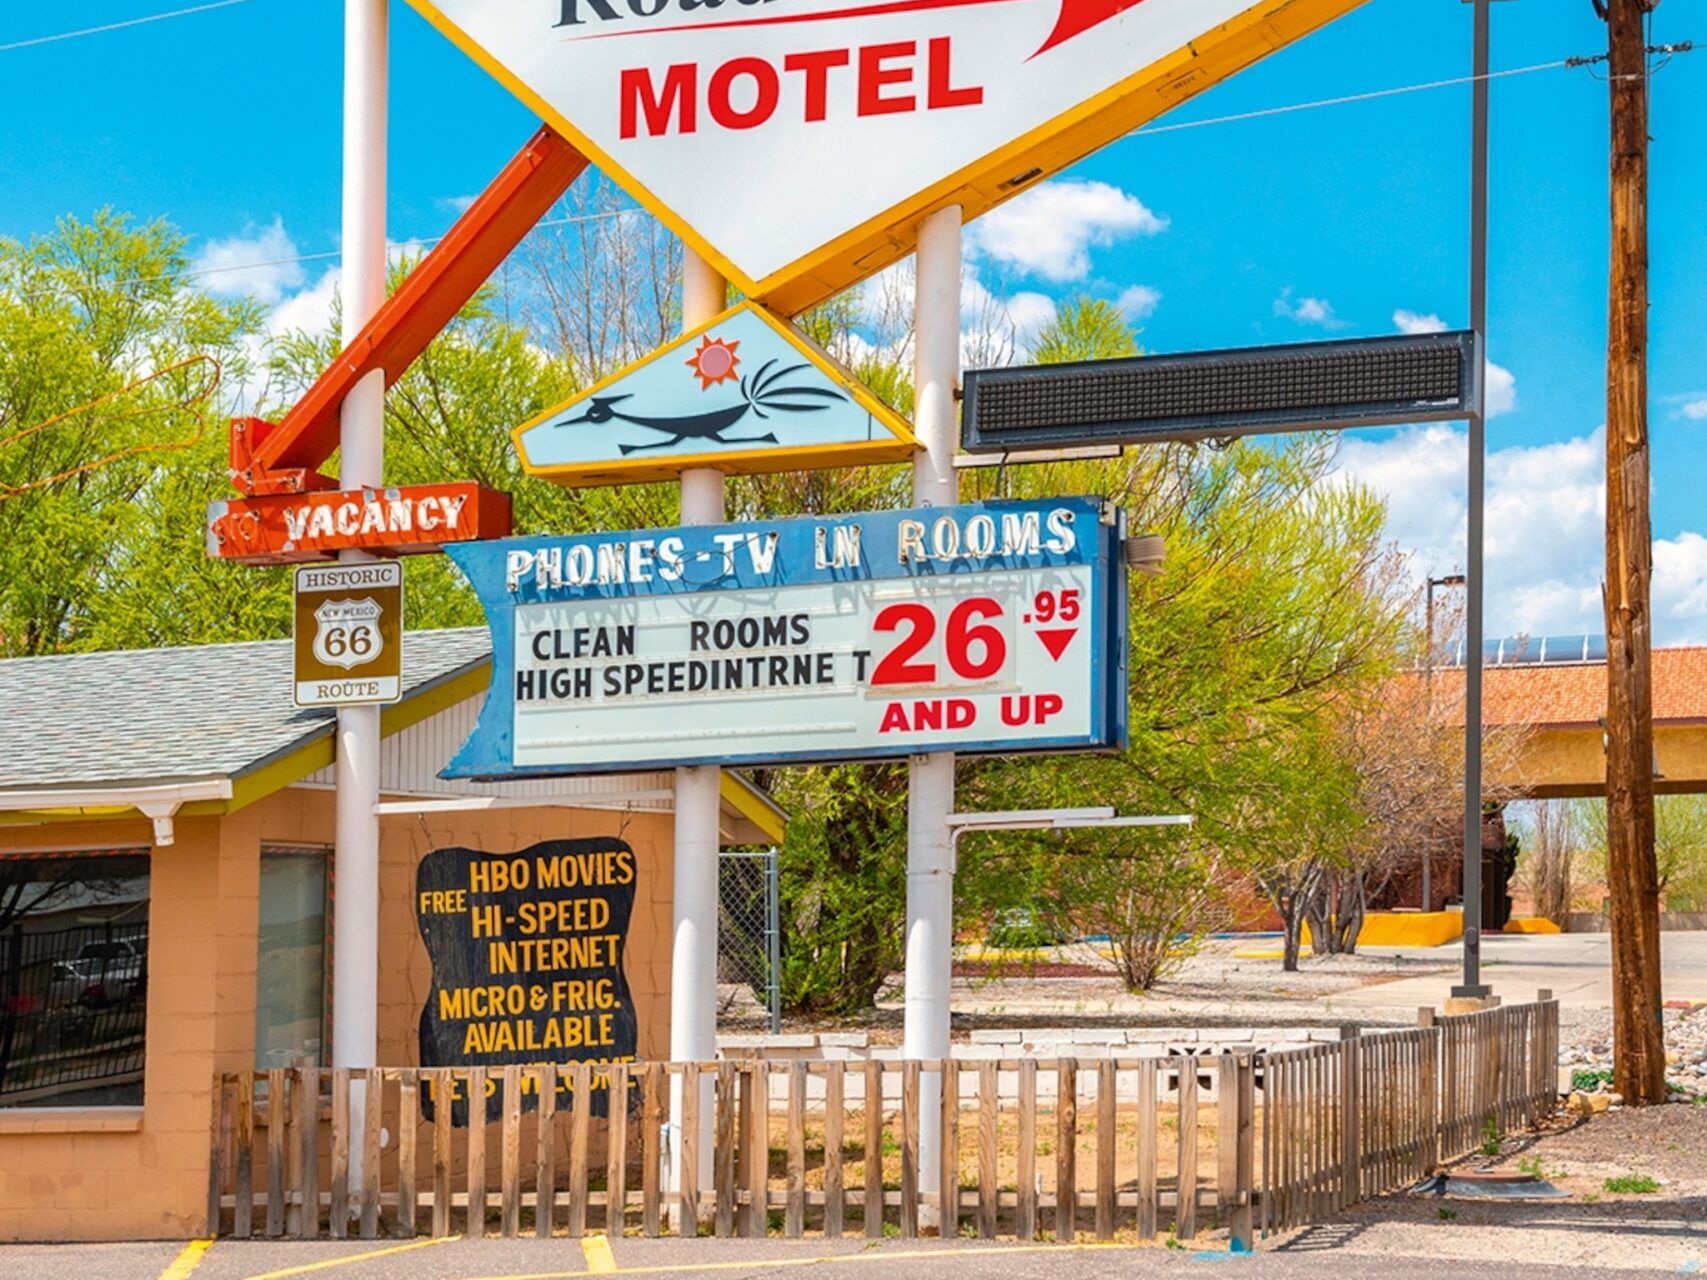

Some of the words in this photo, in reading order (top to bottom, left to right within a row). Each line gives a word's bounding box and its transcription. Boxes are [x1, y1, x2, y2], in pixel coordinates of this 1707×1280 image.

[620, 37, 983, 139] MOTEL
[283, 494, 467, 541] VACANCY
[815, 524, 861, 568] IN
[898, 508, 1076, 565] ROOMS
[305, 568, 392, 587] HISTORIC
[343, 606, 375, 617] MEXICO
[324, 625, 372, 657] 66
[532, 625, 635, 661] CLEAN
[690, 614, 810, 651] ROOMS
[871, 597, 1005, 686] 26
[317, 682, 379, 699] ROUTE
[516, 667, 592, 701] HIGH
[879, 699, 976, 733] AND
[1001, 694, 1063, 727] UP
[470, 858, 530, 893] HBO
[537, 852, 634, 889] MOVIES
[420, 889, 467, 914] FREE
[489, 935, 620, 975] INTERNET
[439, 985, 526, 1020] MICRO
[529, 985, 547, 1011] &
[552, 979, 621, 1012] FRIG.
[463, 1014, 615, 1055] AVAILABLE
